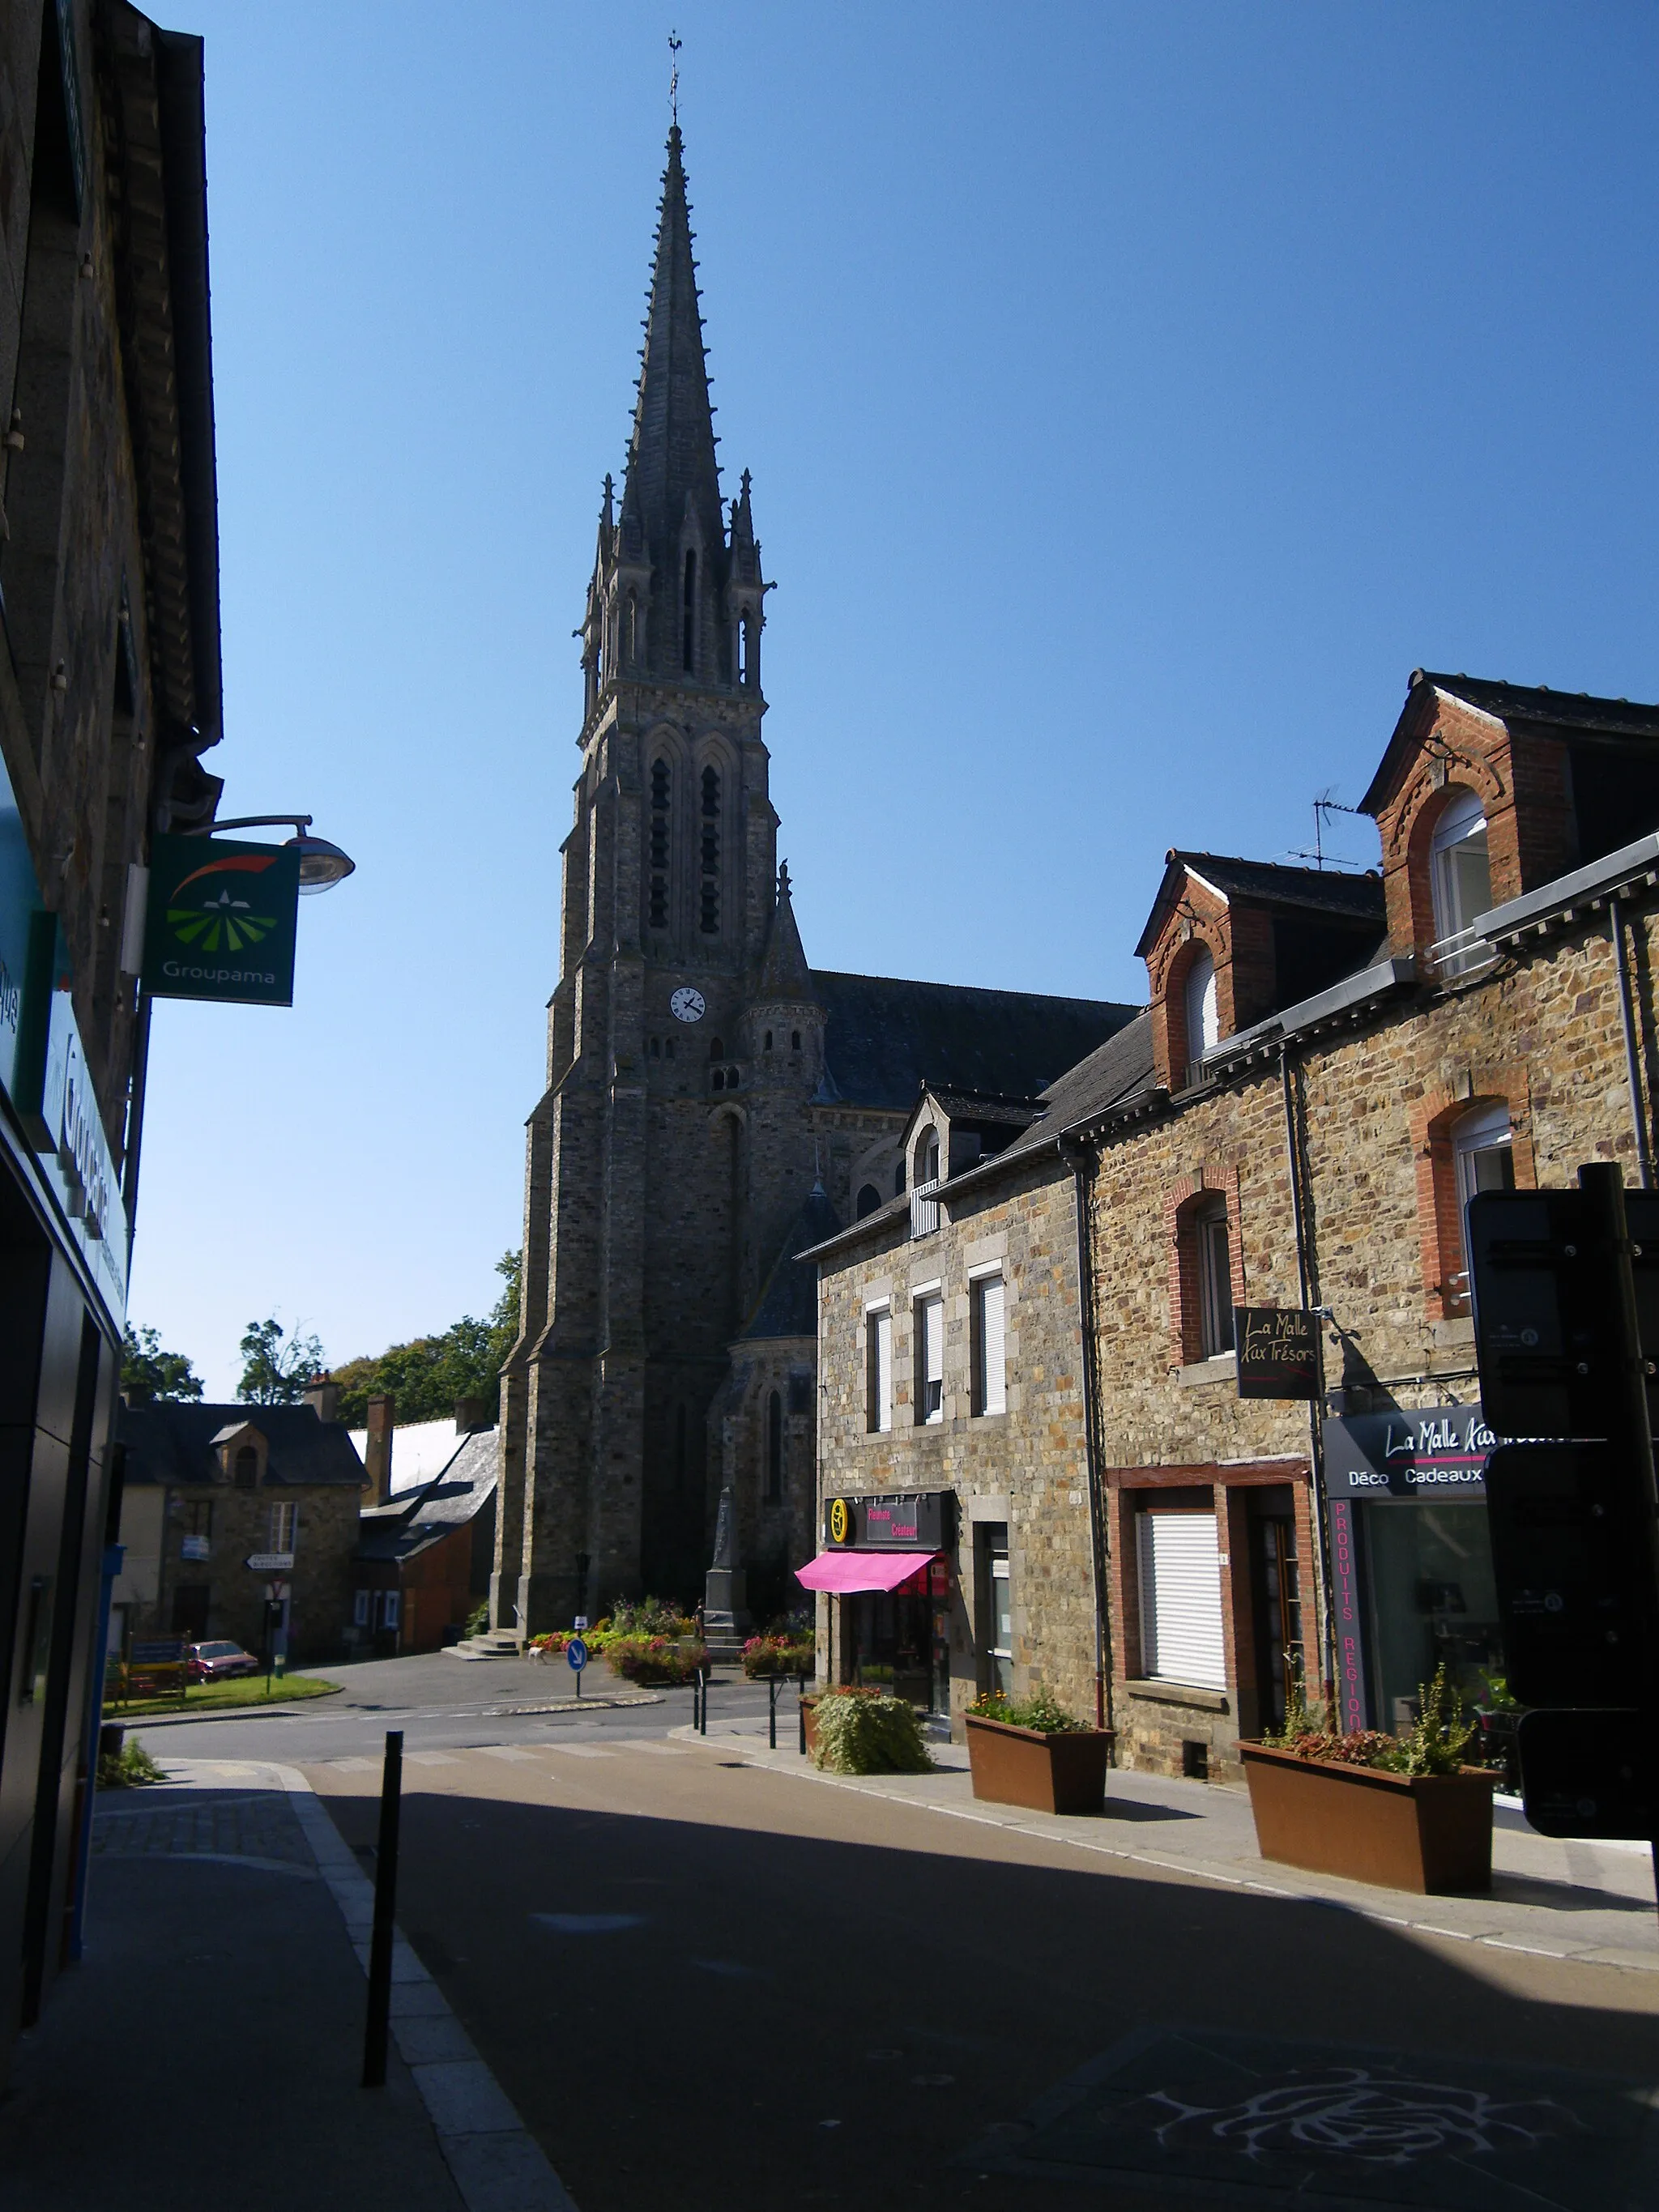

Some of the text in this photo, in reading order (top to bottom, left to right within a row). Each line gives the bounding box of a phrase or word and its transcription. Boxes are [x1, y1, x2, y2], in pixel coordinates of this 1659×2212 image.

[163, 961, 275, 984] Groupama
[64, 1033, 109, 1239] Groupama
[1245, 1313, 1307, 1340] La Malle
[1241, 1338, 1316, 1362] Aux Trésors
[1386, 1417, 1497, 1457] La Malle Aux
[1349, 1468, 1483, 1485] Déco Cadeaux
[868, 1508, 890, 1520] Fleuriste
[892, 1523, 917, 1536] Créateur
[1335, 1503, 1361, 1733] PRODUITS REGION
